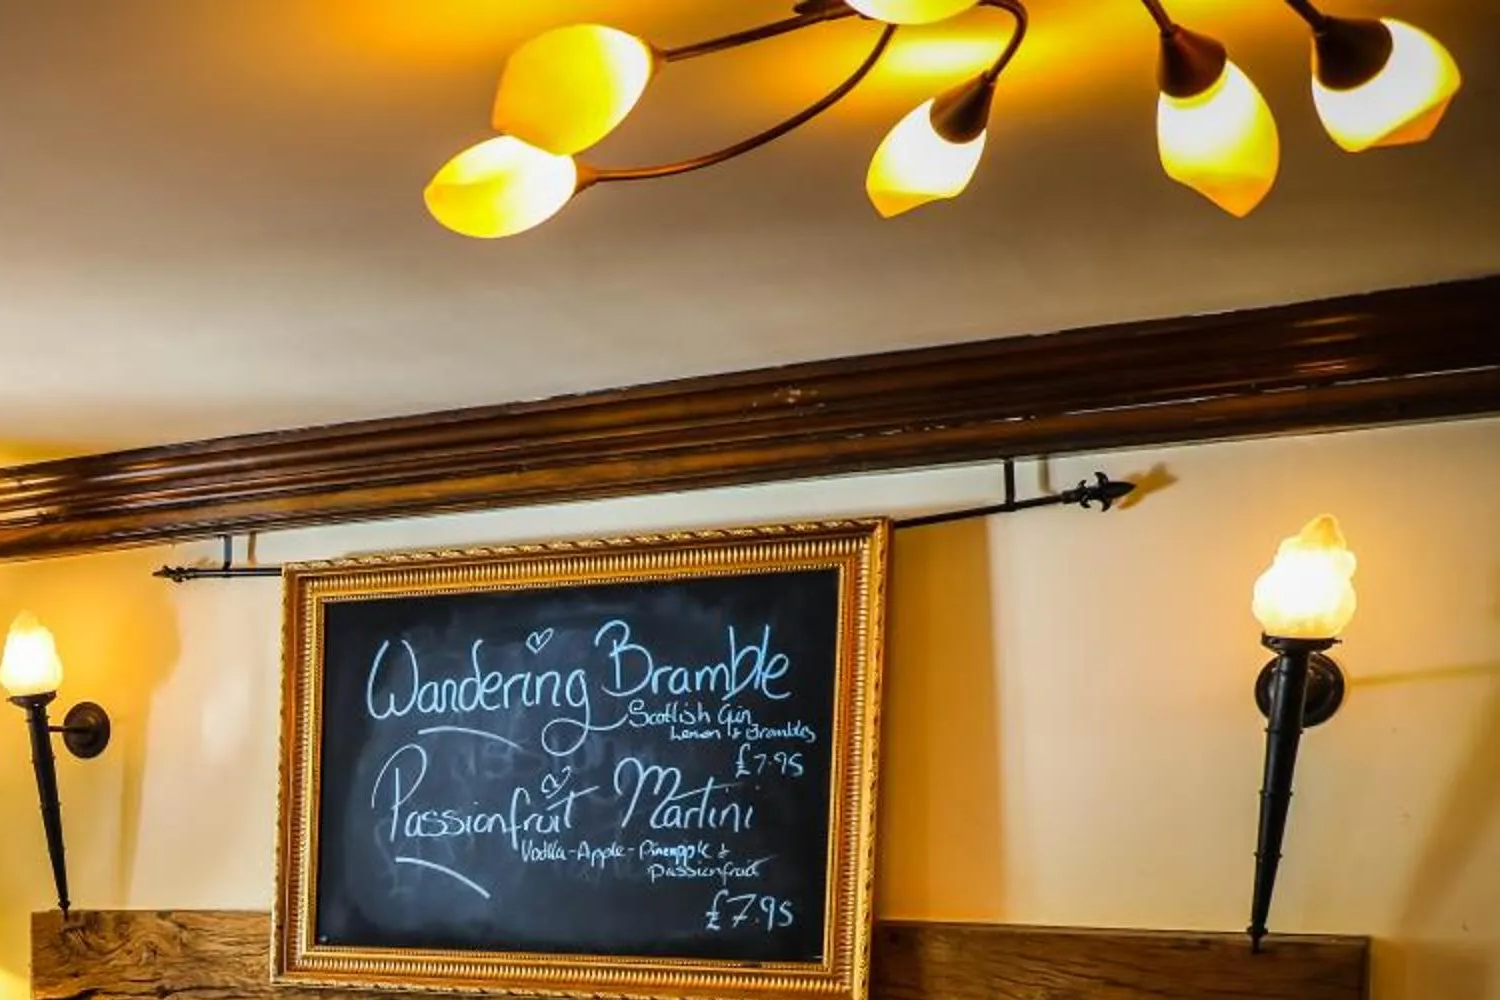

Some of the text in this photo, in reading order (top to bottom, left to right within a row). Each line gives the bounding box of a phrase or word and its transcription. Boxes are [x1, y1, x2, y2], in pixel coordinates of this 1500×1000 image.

[367, 619, 792, 757] Wandering Bramble
[628, 699, 752, 736] Scottish Gin
[669, 724, 722, 741] Lemon
[734, 743, 805, 779] £7.95
[371, 743, 755, 851] Passionfruit Martini
[704, 888, 794, 932] £7.95
